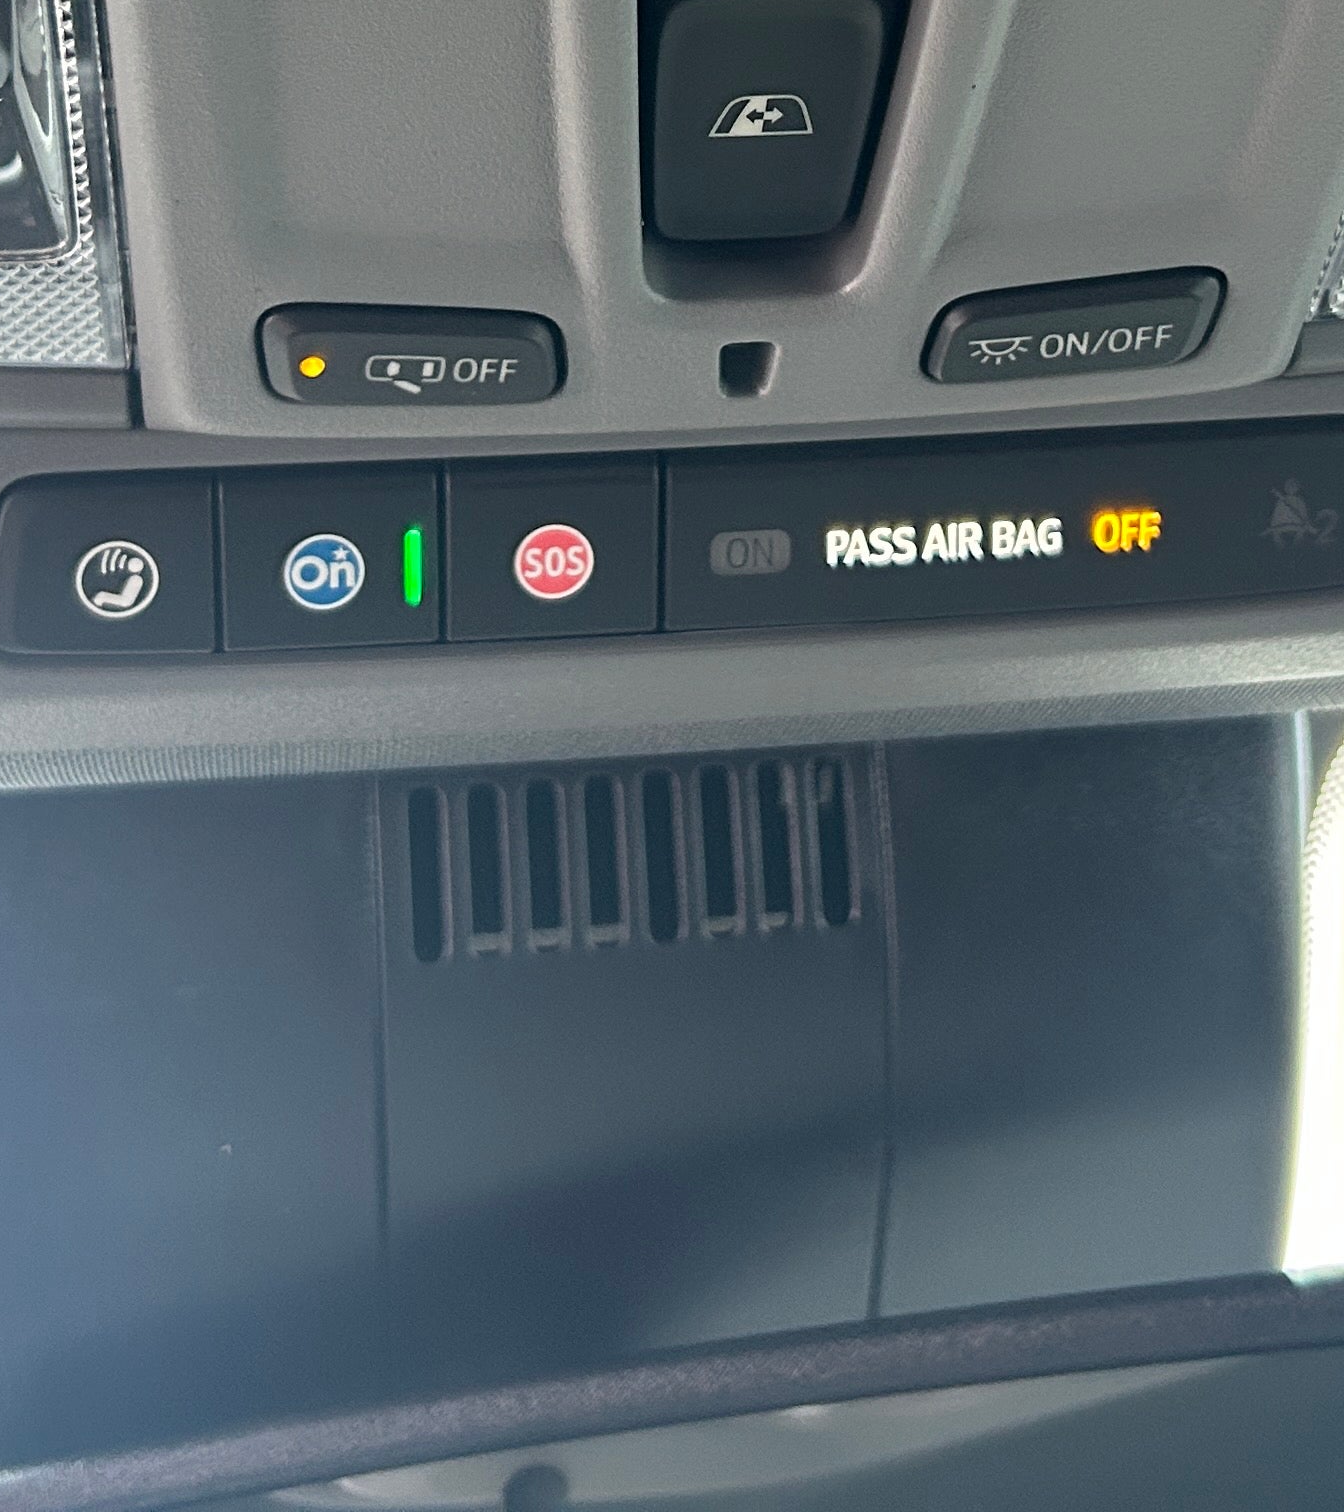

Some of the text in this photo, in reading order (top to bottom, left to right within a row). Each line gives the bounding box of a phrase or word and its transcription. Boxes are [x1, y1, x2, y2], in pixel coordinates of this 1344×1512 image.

[1038, 323, 1174, 359] ON/OFF
[452, 356, 520, 385] OFF
[726, 537, 775, 568] ON
[825, 510, 1162, 568] PASS AIR BAG OFF
[291, 552, 356, 590] On
[524, 545, 586, 581] SOS
